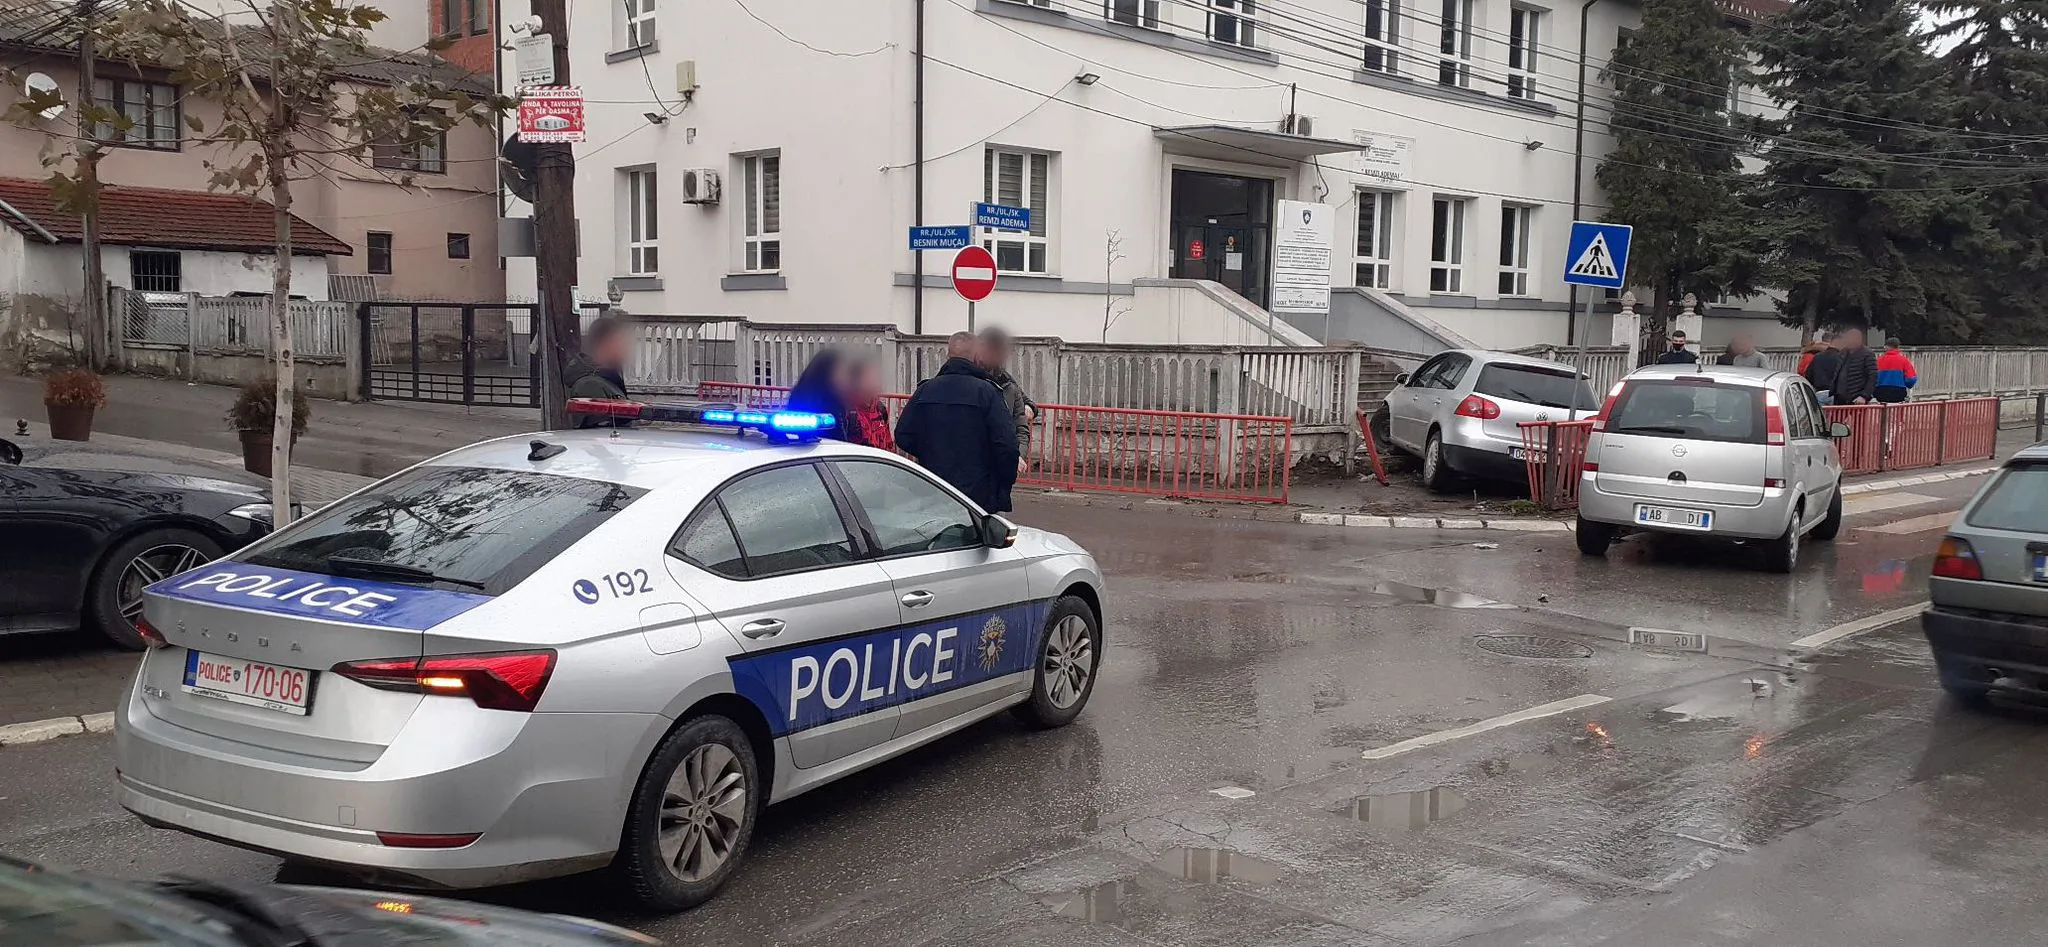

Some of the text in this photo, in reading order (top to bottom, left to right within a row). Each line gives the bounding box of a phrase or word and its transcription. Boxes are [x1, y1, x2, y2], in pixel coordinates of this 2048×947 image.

[548, 107, 570, 115] DASMA
[978, 215, 1028, 229] REMZI ADEMAJ
[913, 238, 966, 248] BESNIK MUÇAJ
[1648, 509, 1700, 525] AB DI
[602, 568, 654, 598] 192
[178, 572, 398, 616] POLICE
[197, 660, 232, 684] POLICE
[788, 627, 958, 721] POLICE
